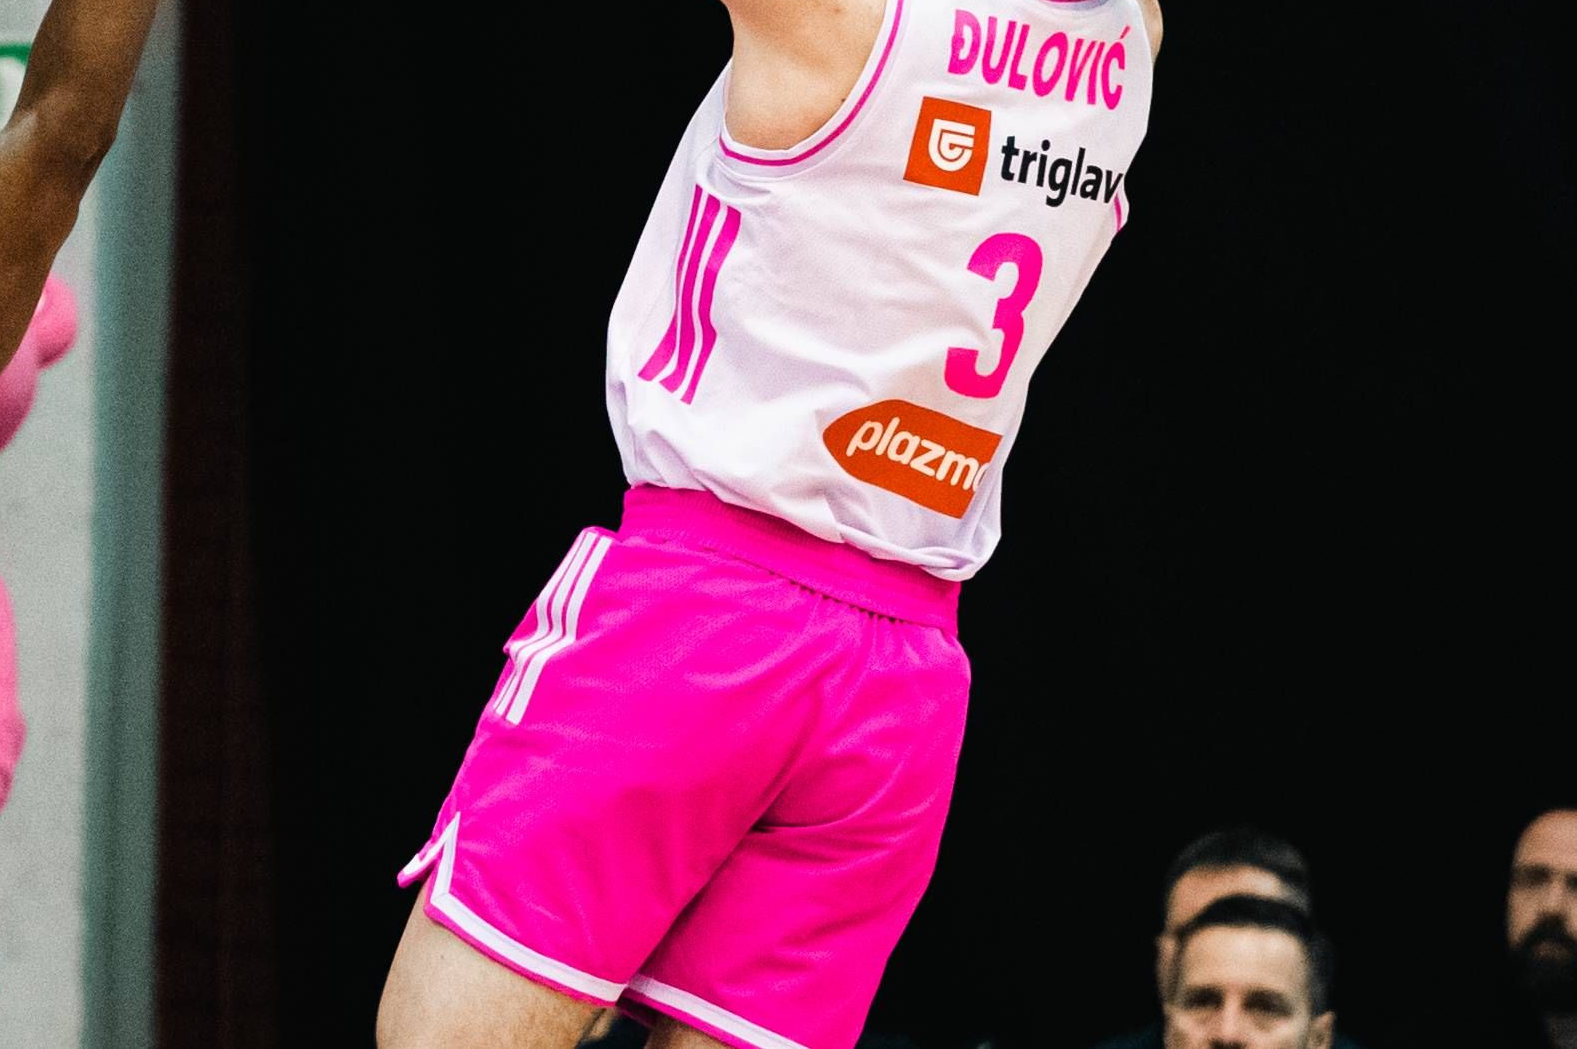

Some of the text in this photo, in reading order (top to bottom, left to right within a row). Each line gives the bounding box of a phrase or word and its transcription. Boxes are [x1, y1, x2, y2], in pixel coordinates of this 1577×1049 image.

[947, 9, 1131, 110] ĐULOVIĆ
[1001, 135, 1124, 208] triglav
[944, 232, 1043, 398] 3
